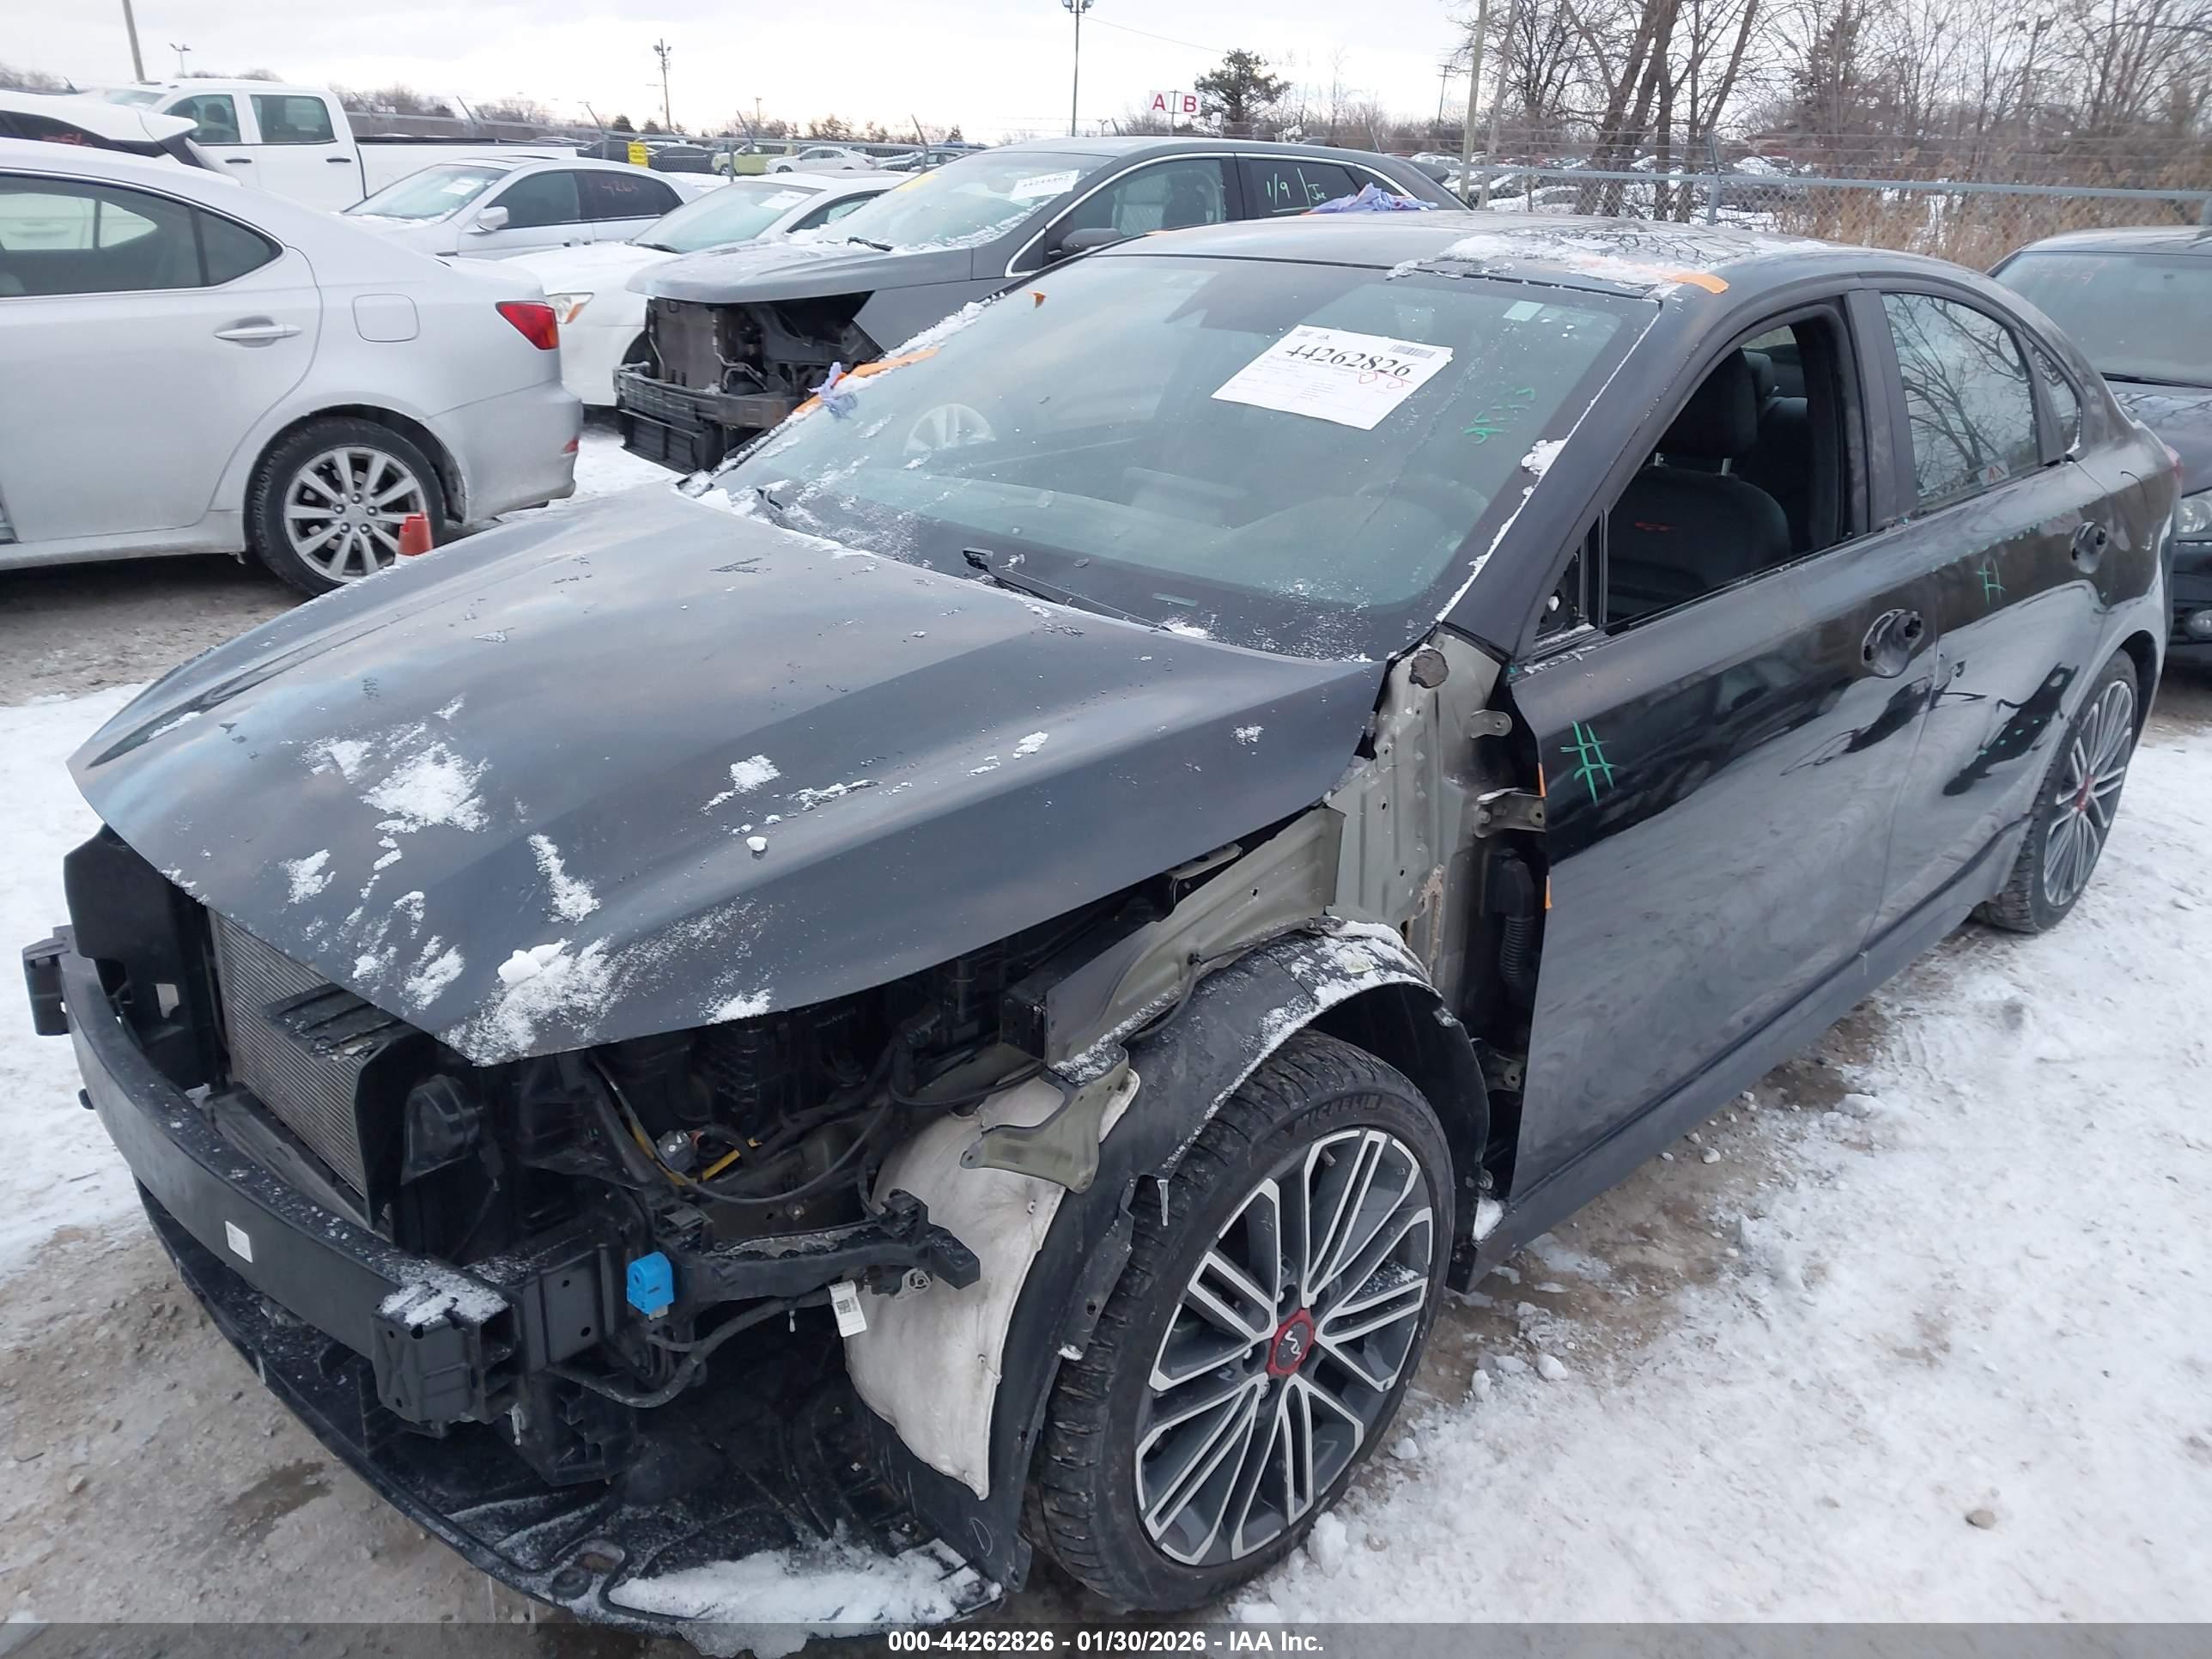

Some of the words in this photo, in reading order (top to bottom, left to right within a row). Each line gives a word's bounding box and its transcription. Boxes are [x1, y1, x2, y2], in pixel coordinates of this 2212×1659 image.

[1152, 94, 1166, 112] A
[1183, 95, 1196, 112] B
[1266, 172, 1291, 205] 1/9
[1285, 343, 1419, 377] 44262826
